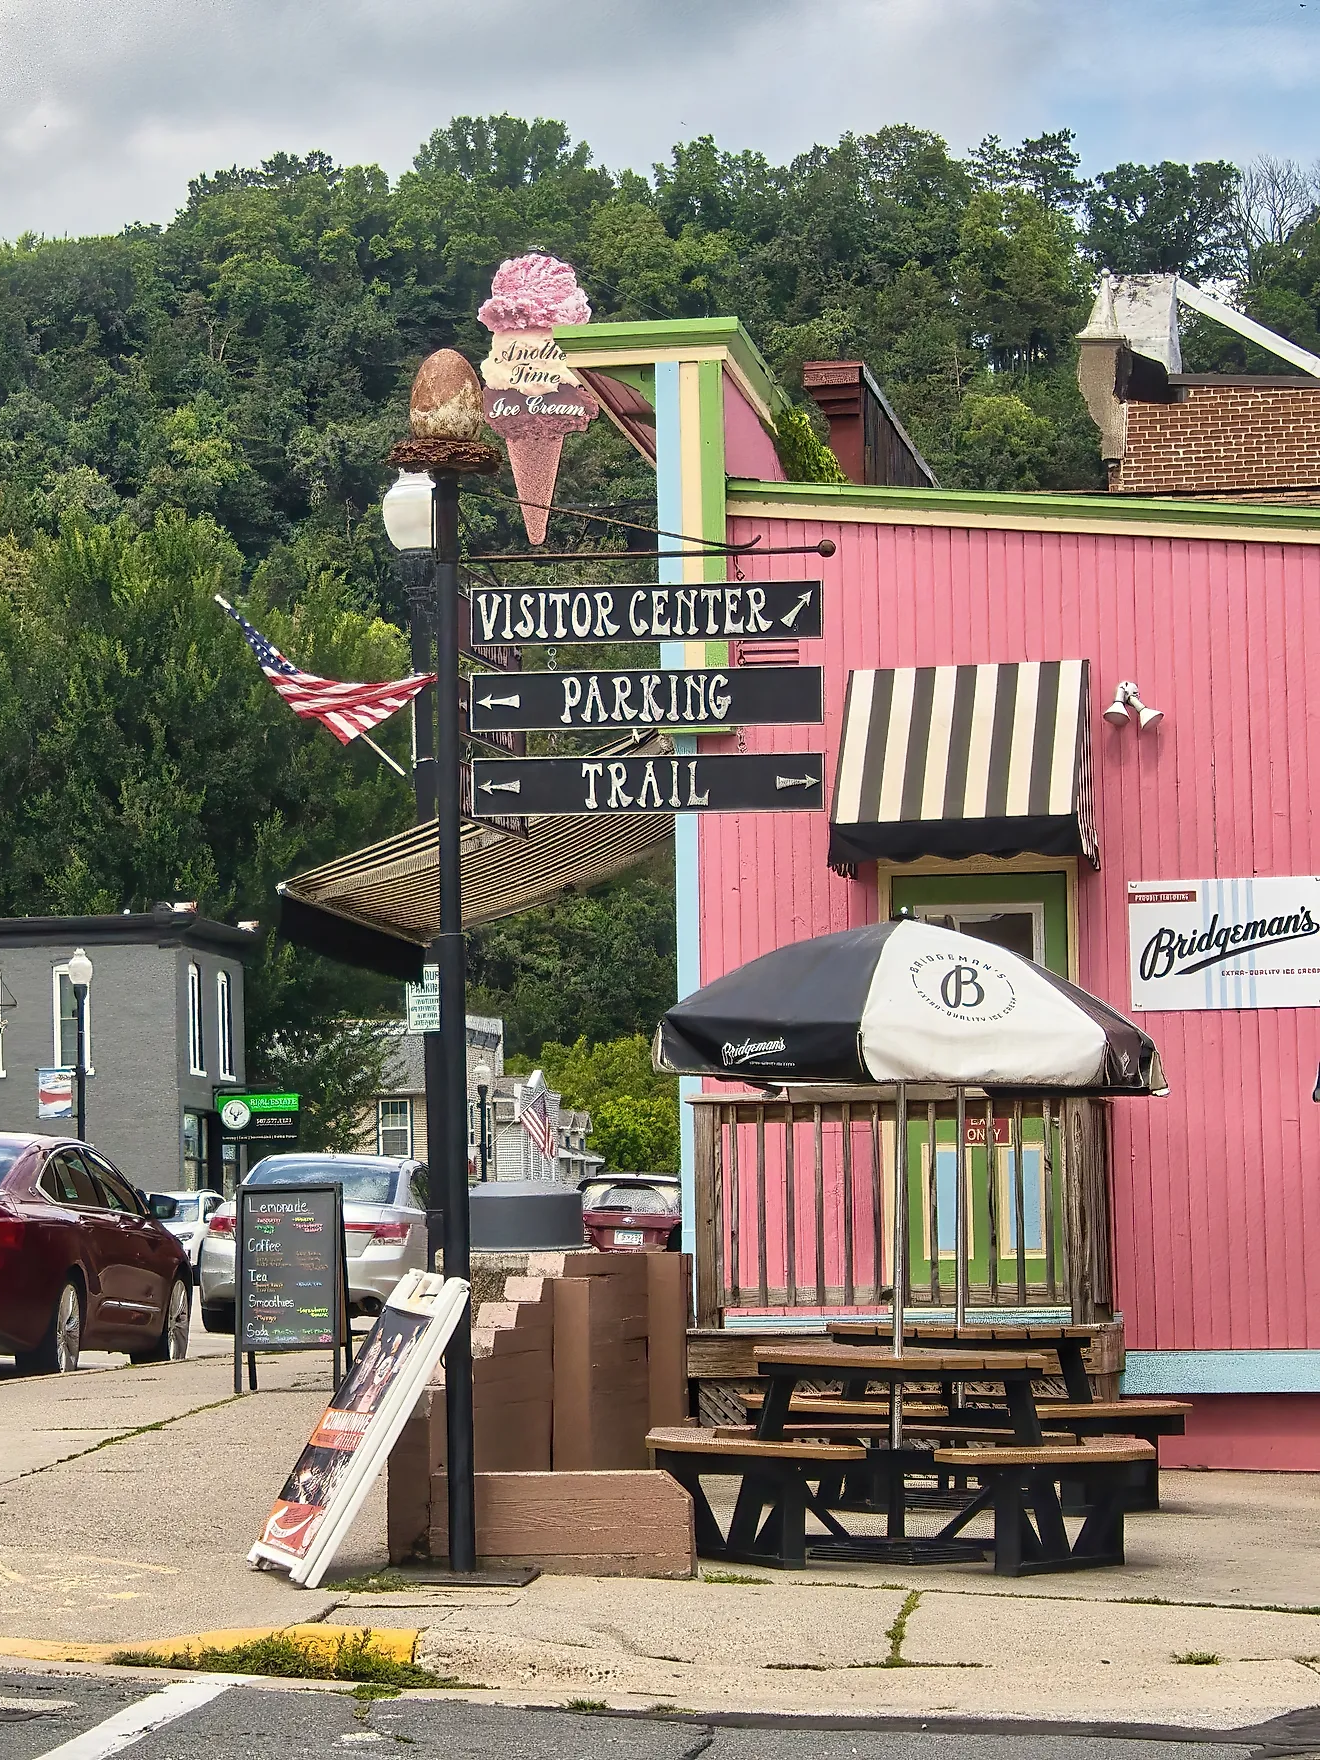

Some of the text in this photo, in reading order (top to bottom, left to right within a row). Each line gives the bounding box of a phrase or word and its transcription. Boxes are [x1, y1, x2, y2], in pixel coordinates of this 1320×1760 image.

[494, 341, 567, 364] Anothe
[509, 363, 560, 385] Time
[489, 395, 585, 419] Ice Cream
[477, 588, 773, 640] VISITOR CENTER
[560, 674, 731, 724] PARKING
[581, 760, 709, 810] TRAIL
[1139, 906, 1320, 981] Bridgeman's
[909, 953, 1007, 979] BRIDGEMAN'S
[721, 1036, 786, 1066] Bridgeman's
[967, 1128, 1001, 1141] ONY
[248, 1196, 309, 1213] Lemonade
[247, 1238, 282, 1252] Coffee
[247, 1268, 268, 1282] Tea
[248, 1293, 295, 1308] Smoothies
[246, 1322, 270, 1338] Soda
[322, 1411, 374, 1432] COMMONWE
